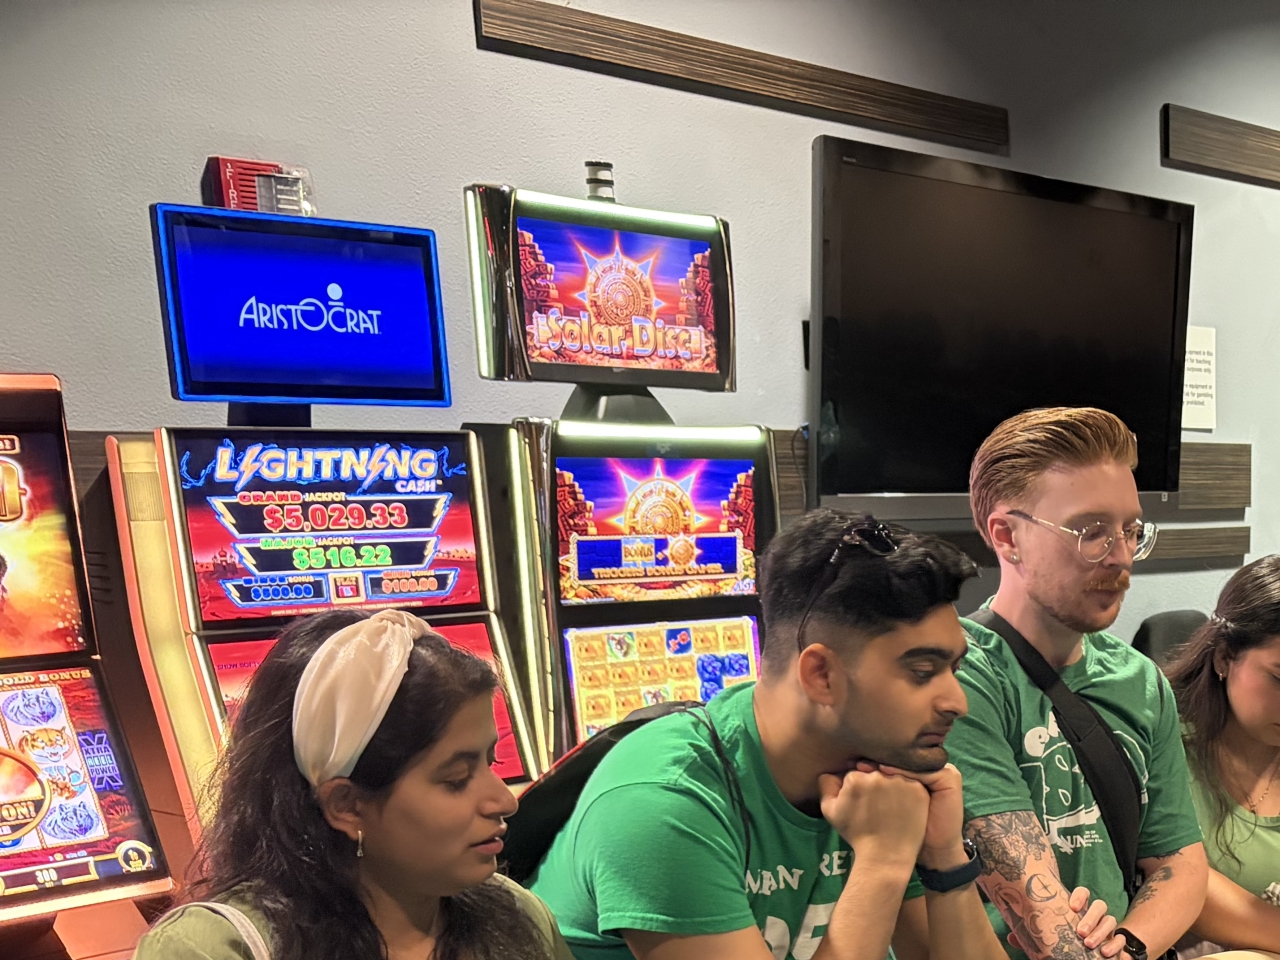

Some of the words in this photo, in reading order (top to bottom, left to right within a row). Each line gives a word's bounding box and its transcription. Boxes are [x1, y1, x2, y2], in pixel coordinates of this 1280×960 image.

[225, 168, 238, 209] FIRE
[239, 296, 382, 335] ARISTOCRAT
[547, 307, 627, 354] Solar
[632, 315, 694, 360] Disc
[214, 443, 438, 492] LIGHTNING
[237, 491, 303, 505] GRAND
[304, 491, 347, 503] JACKPOT
[263, 503, 408, 533] $5,029.33
[260, 537, 316, 549] MAJOR
[317, 536, 355, 547] JACKPOT
[623, 544, 654, 559] BONUS
[293, 545, 392, 571] $516.22
[251, 584, 314, 601] $500.00
[0, 674, 36, 687] OLD
[38, 669, 92, 684] BONUS
[90, 765, 118, 777] POWER
[35, 868, 58, 884] 300
